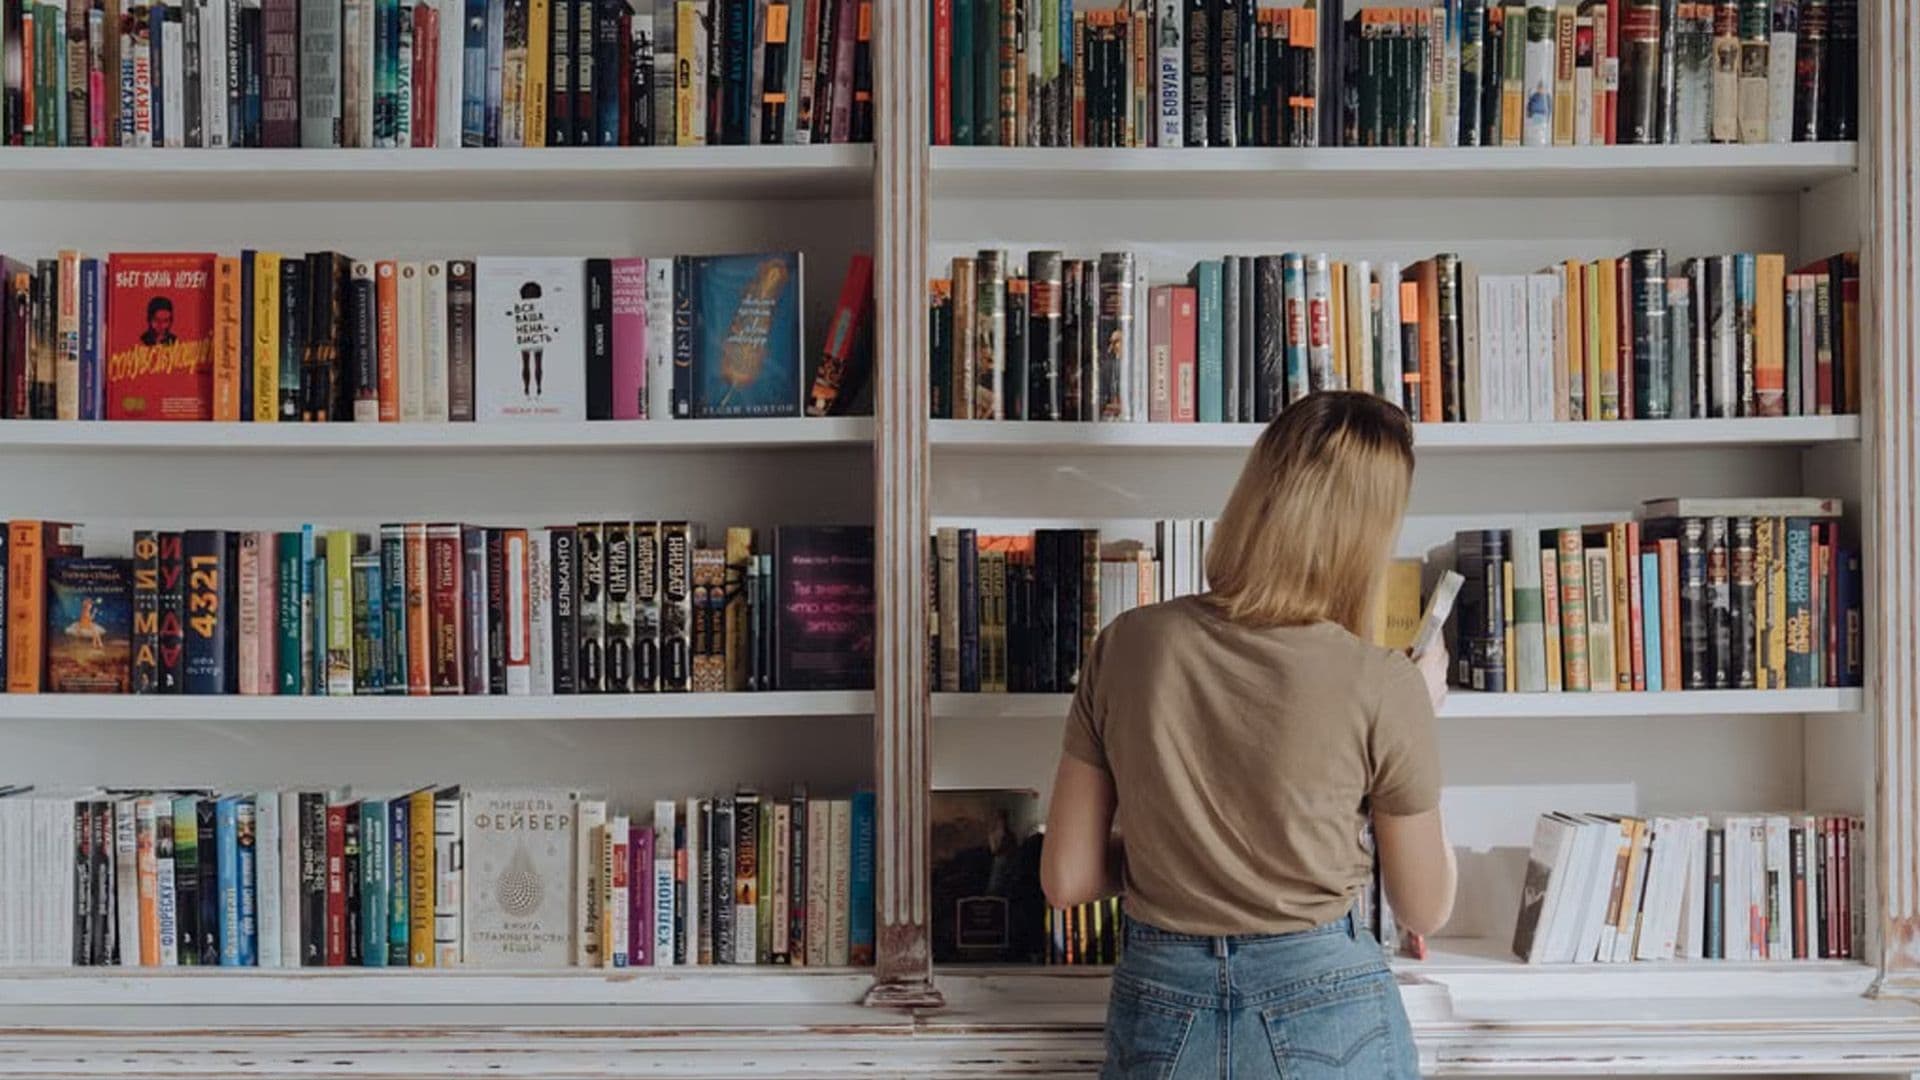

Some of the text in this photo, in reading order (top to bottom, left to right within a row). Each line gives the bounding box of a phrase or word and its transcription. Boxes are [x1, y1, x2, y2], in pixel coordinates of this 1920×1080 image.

[557, 536, 571, 617] БЕЛЬКАНТО
[608, 540, 627, 593] ПАРИЖ
[667, 536, 684, 596] ДУБЛИН
[189, 554, 219, 639] 4321
[474, 811, 570, 831] ФЕЙБЕР
